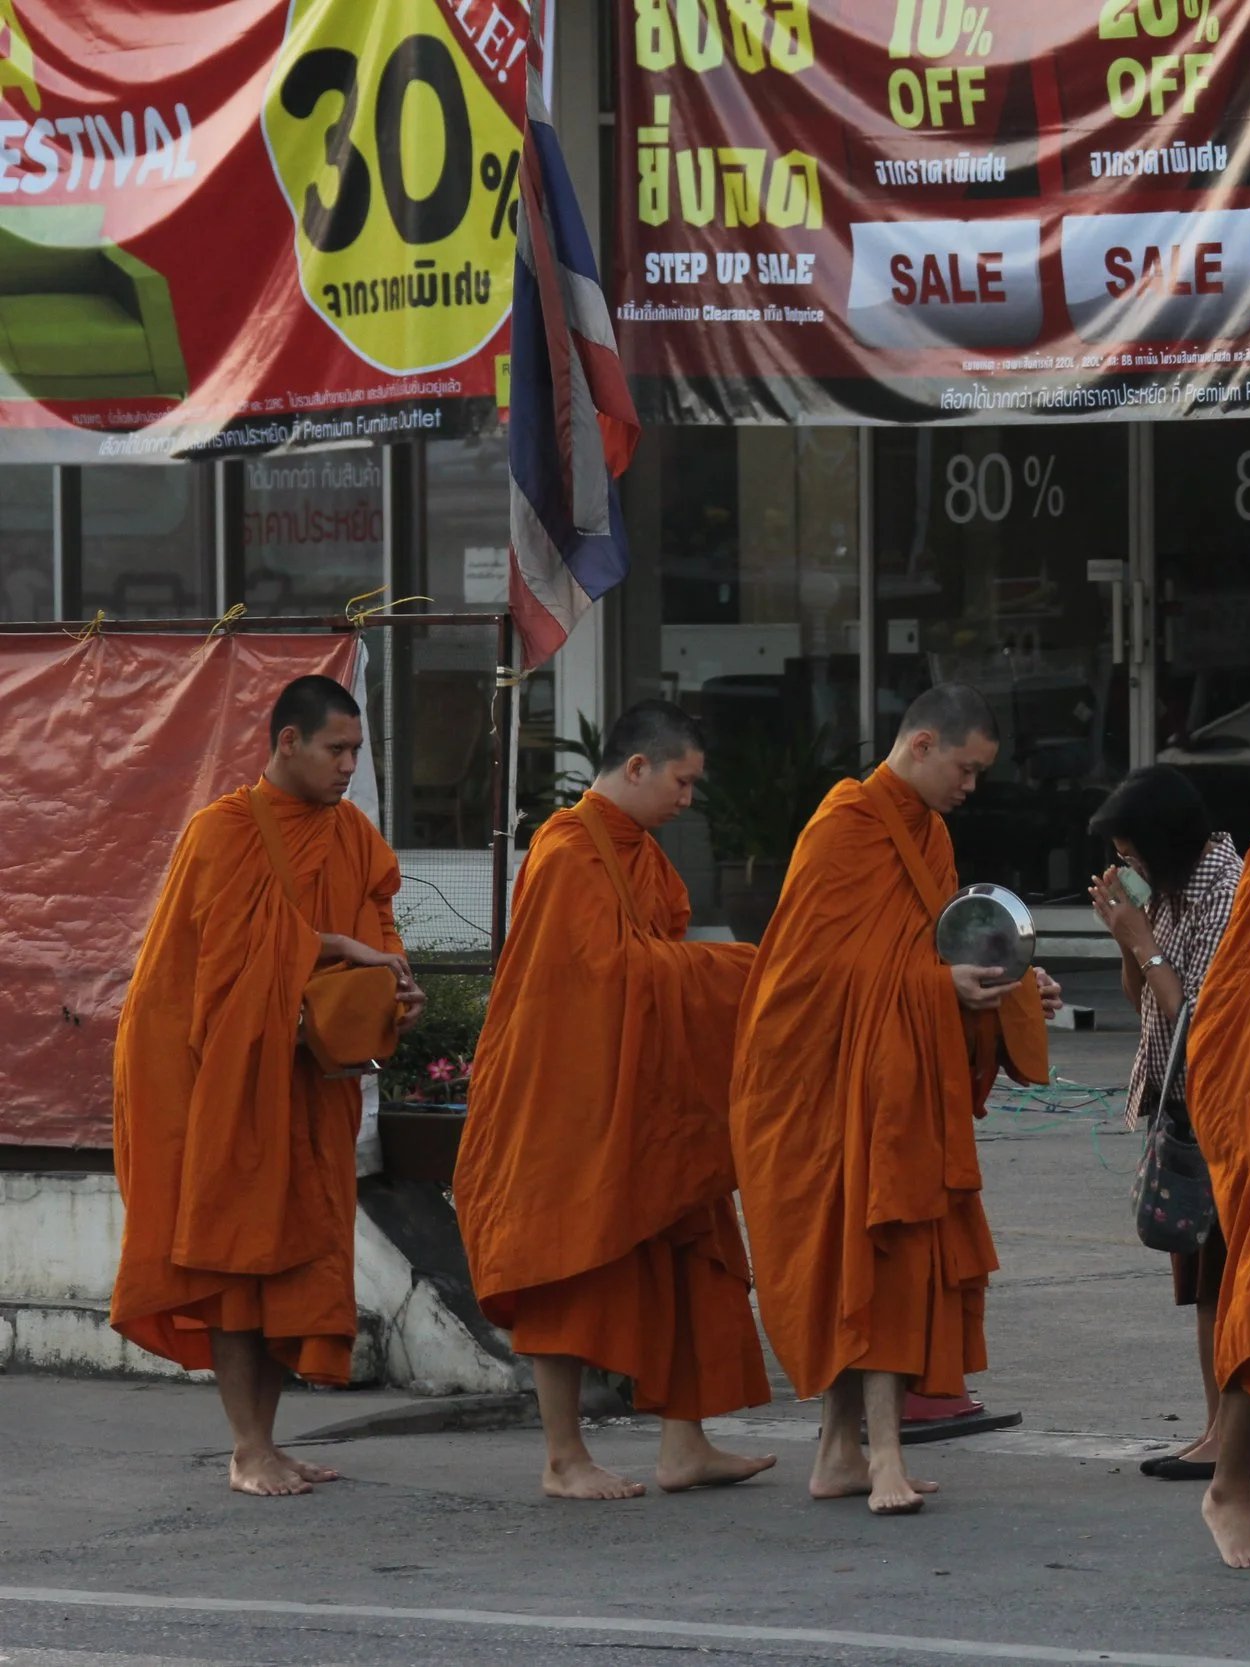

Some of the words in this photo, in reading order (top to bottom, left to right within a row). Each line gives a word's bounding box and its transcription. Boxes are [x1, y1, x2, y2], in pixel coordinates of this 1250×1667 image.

[888, 66, 986, 129] OFF
[1106, 53, 1214, 120] OFF
[875, 153, 1007, 186] จากราคาพิเศษ
[1089, 140, 1228, 178] จากราคาพิเศษ
[322, 259, 492, 319] จากราคาพิเศษ
[645, 253, 710, 284] STEP
[716, 253, 751, 284] UP
[758, 252, 816, 285] SALE
[890, 252, 1006, 306] SALE
[1104, 242, 1224, 299] SALE
[702, 305, 761, 321] Clearance
[1185, 381, 1241, 405] Premium
[303, 418, 353, 442] Premium
[357, 415, 398, 437] Furniture
[399, 407, 442, 431] Outlet
[944, 453, 1065, 524] 80%
